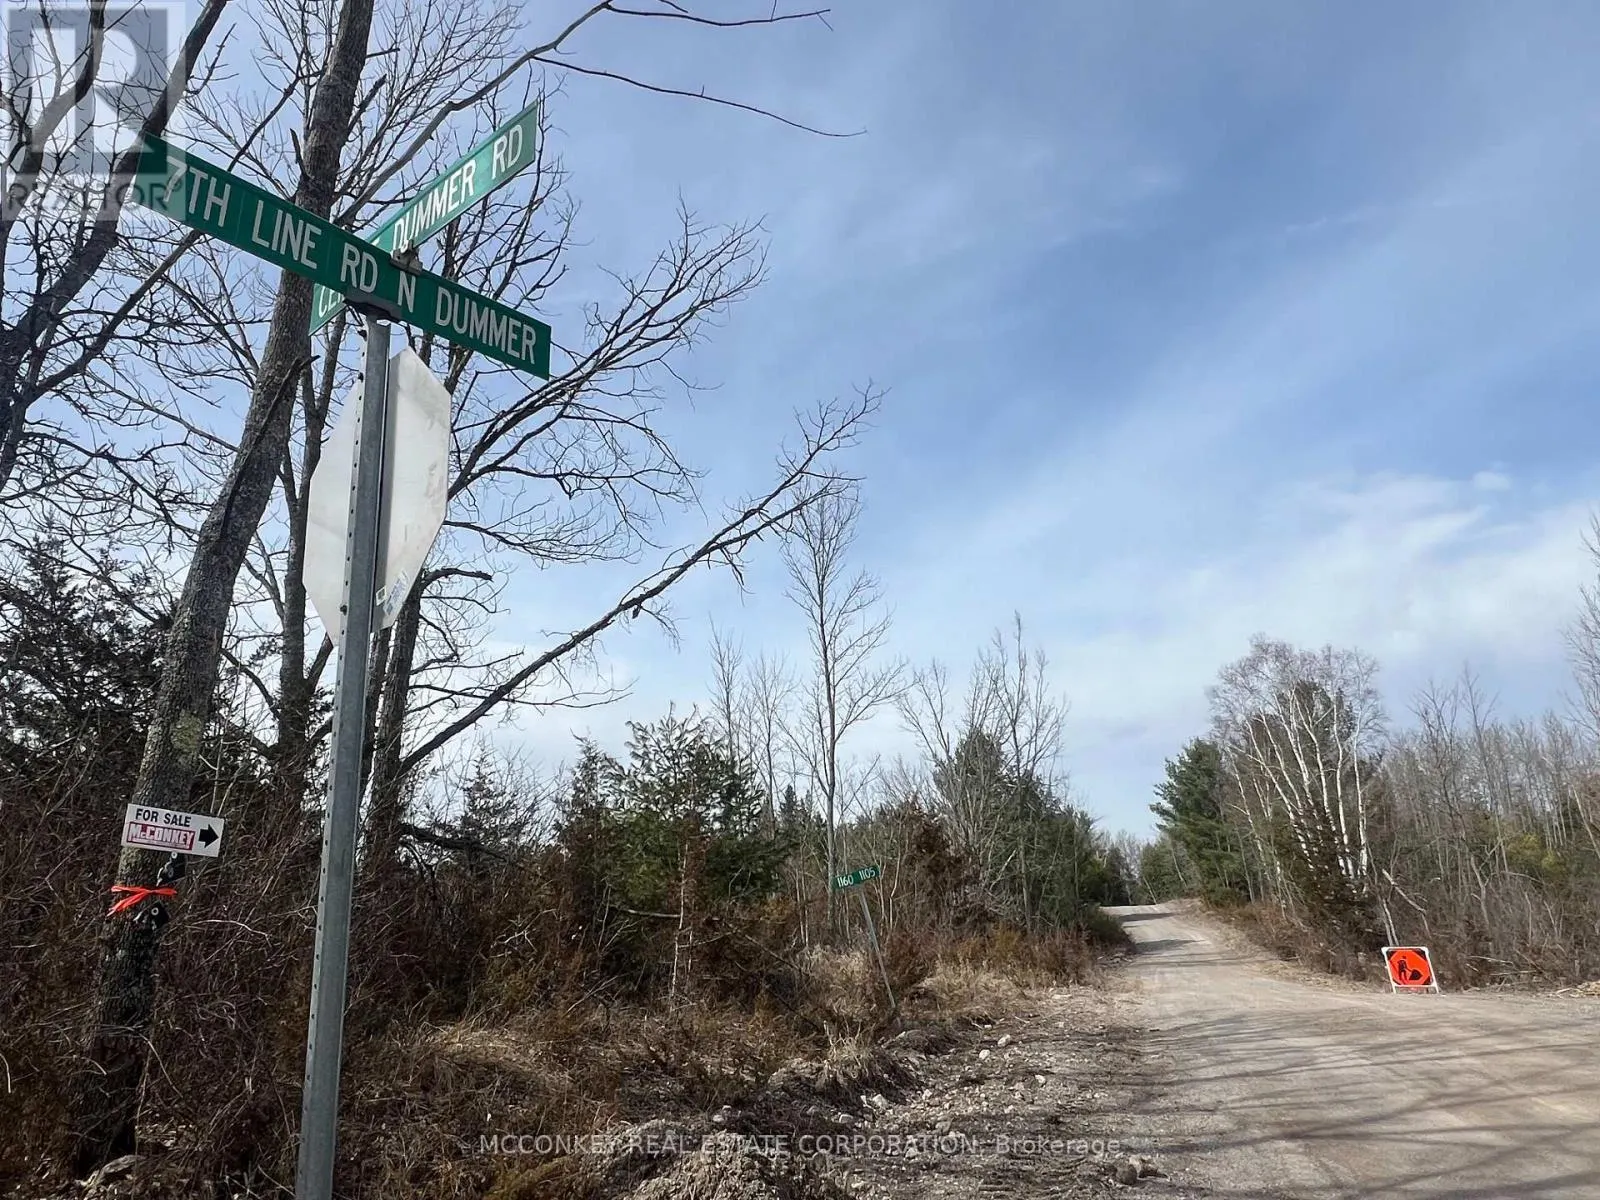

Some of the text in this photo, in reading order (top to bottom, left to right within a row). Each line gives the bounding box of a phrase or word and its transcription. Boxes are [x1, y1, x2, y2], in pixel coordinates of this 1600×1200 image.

[391, 124, 523, 257] DUMMER RD
[163, 156, 232, 228] 7TH
[252, 200, 322, 270] LINE
[341, 242, 378, 293] RD
[397, 270, 416, 313] N
[435, 286, 537, 364] DUMMER
[135, 807, 192, 828] FOR SALE
[837, 867, 876, 888] 1160 1105
